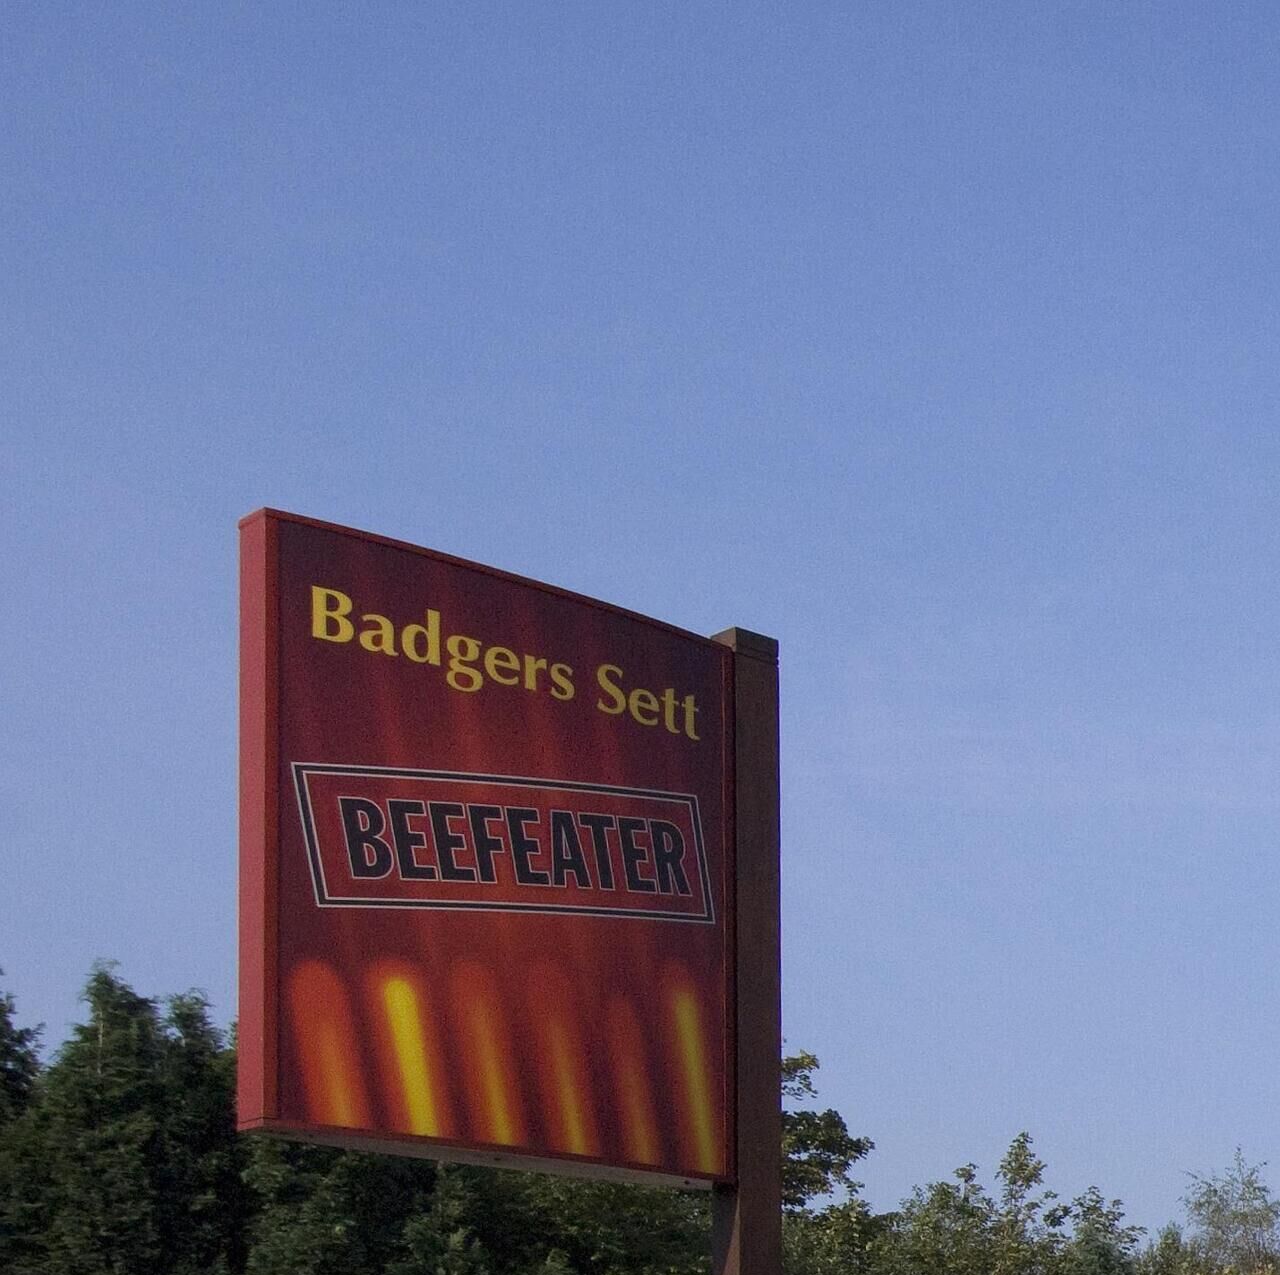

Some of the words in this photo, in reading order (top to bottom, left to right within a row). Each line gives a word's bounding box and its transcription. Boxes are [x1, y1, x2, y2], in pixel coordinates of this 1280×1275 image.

[311, 585, 576, 700] Badgers
[597, 663, 701, 740] Sett
[337, 796, 694, 897] BEEFEATER
